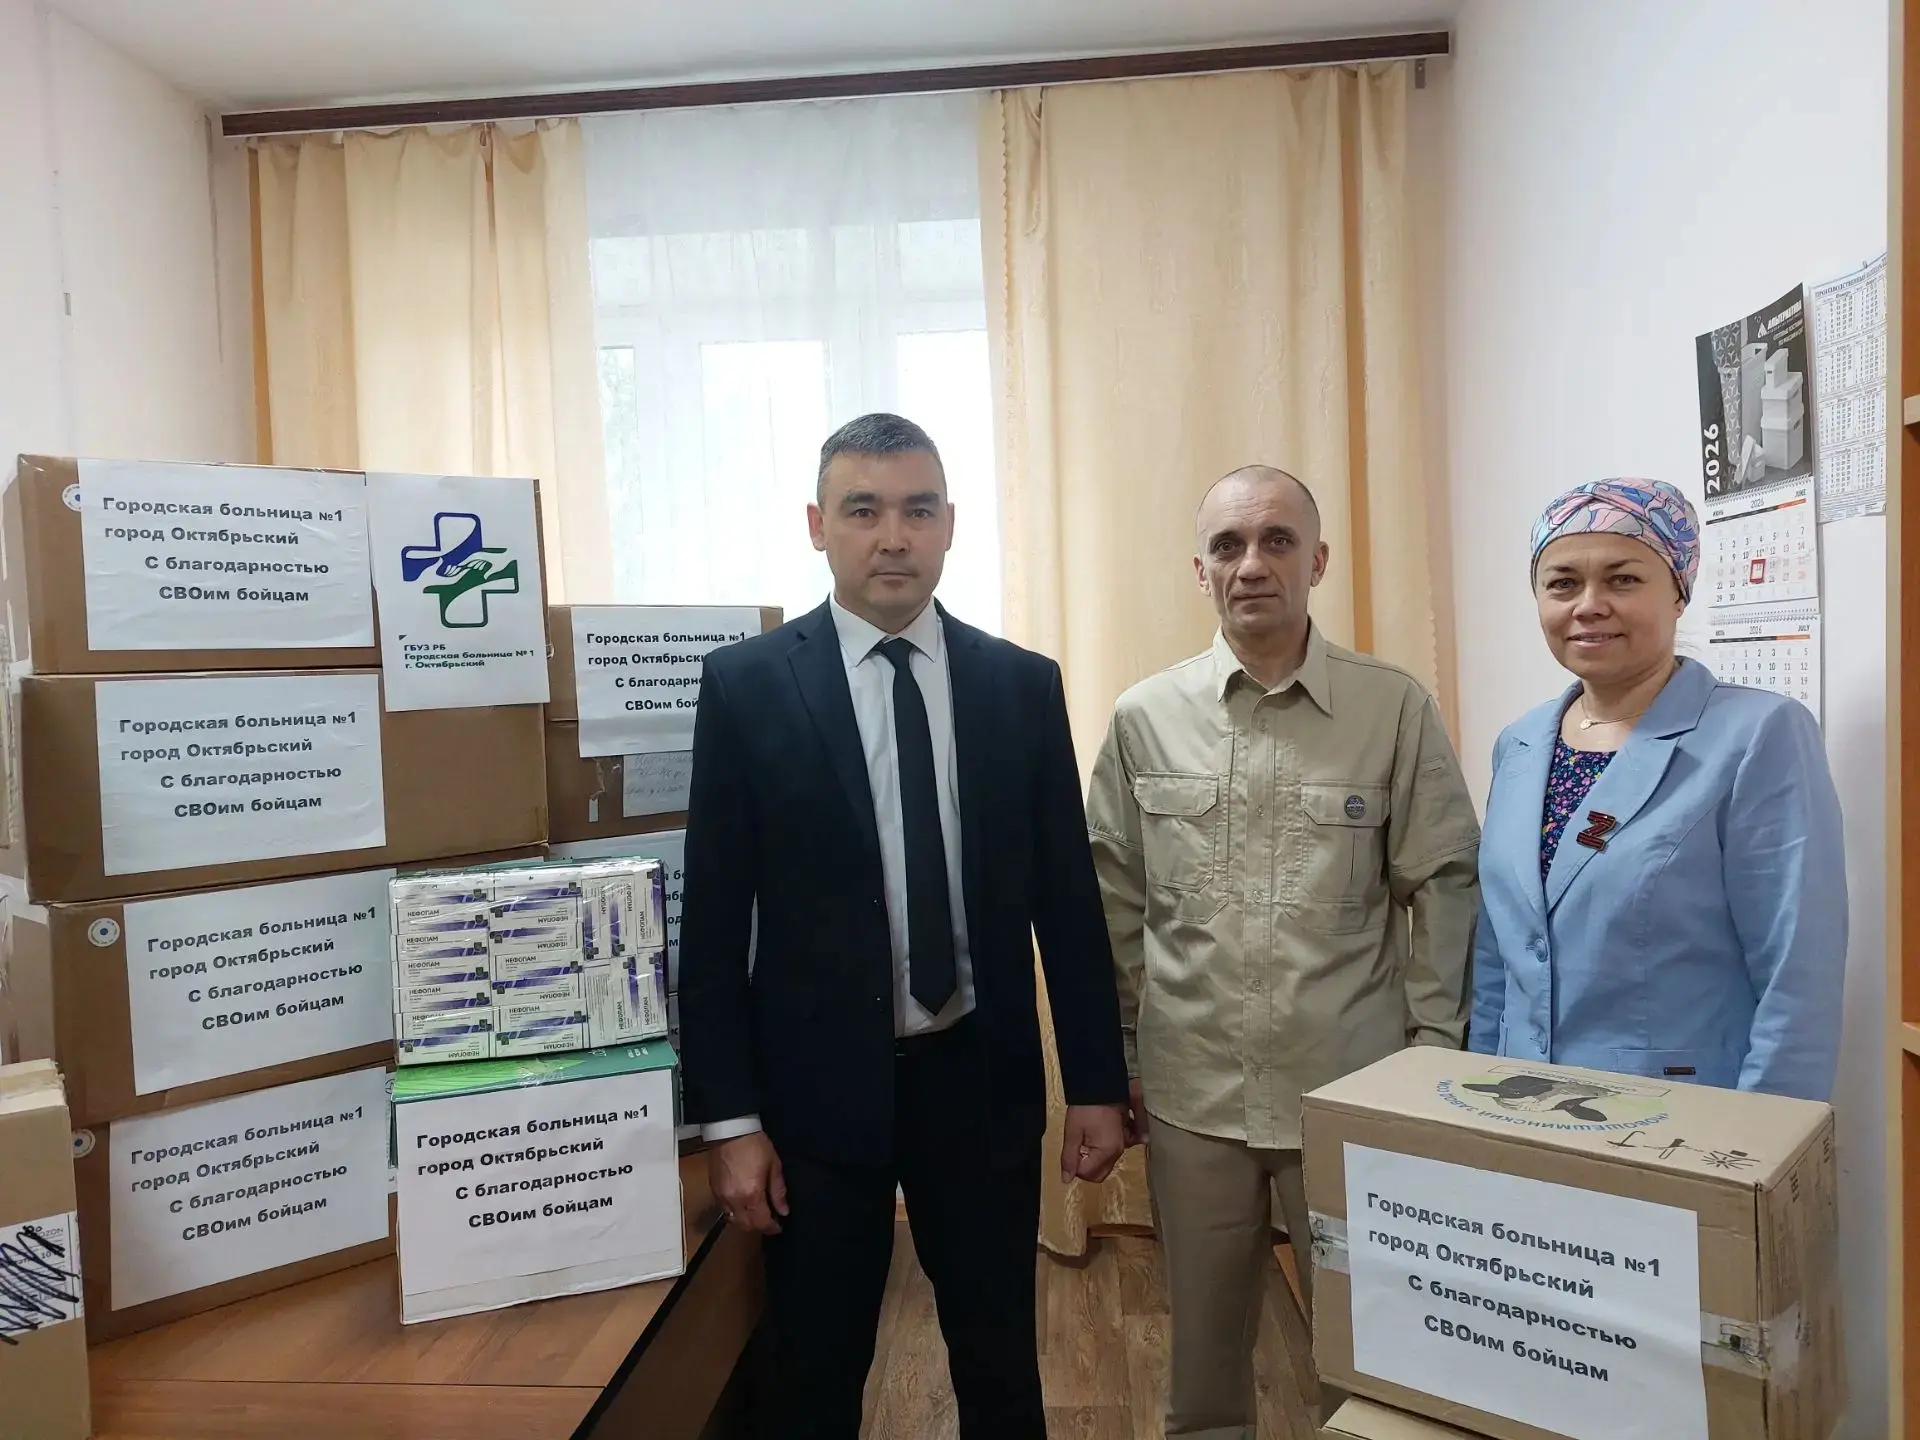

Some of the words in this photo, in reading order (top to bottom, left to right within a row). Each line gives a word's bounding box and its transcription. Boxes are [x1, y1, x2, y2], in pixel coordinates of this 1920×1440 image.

[1704, 423, 1721, 494] 2026
[102, 497, 213, 515] Городская
[219, 503, 313, 522] больница
[318, 509, 344, 522] №1
[104, 526, 165, 541] город
[171, 527, 300, 545] Октябрьский
[144, 556, 159, 570] С
[165, 556, 330, 575] благодарностью
[159, 585, 231, 601] СВОим
[236, 586, 310, 603] бойцам
[432, 643, 447, 651] РБ
[587, 633, 659, 646] Городская
[663, 631, 725, 644] больница
[729, 631, 746, 642] №1
[404, 652, 460, 661] Городская
[462, 650, 513, 659] больница
[415, 659, 485, 670] Октябрьский
[588, 655, 628, 667] город
[631, 653, 703, 666] Октябрьск
[1769, 662, 1775, 670] 10
[1784, 662, 1791, 670] 11
[1801, 662, 1808, 670] 12
[615, 677, 625, 688] С
[628, 676, 702, 688] благодарн
[1755, 676, 1761, 685] 16
[1769, 676, 1775, 685] 17
[1801, 677, 1808, 685] 19
[625, 699, 672, 712] СВОим
[676, 697, 699, 709] бой
[1801, 691, 1808, 700] 26
[119, 718, 229, 735] Городская
[234, 712, 327, 730] больница
[331, 711, 357, 725] №1
[120, 745, 181, 763] город
[186, 737, 313, 757] Октябрьский
[160, 775, 174, 789] С
[180, 765, 342, 788] благодарностью
[174, 801, 245, 818] СВОим
[250, 796, 322, 813] бойцам
[147, 927, 253, 953] Городская
[258, 912, 348, 936] больница
[352, 906, 377, 922] №1
[406, 935, 439, 944] НЕФОПАМ
[149, 958, 207, 980] город
[212, 938, 335, 970] Октябрьский
[505, 955, 537, 964] НЕФОПАМ
[188, 989, 201, 1003] С
[207, 962, 363, 1000] благодарностью
[201, 1008, 270, 1030] СВОим
[275, 994, 344, 1018] бойцам
[131, 1133, 238, 1165] Городская
[244, 1114, 334, 1142] больница
[339, 1106, 364, 1123] №1
[417, 1124, 521, 1149] Городская
[526, 1110, 618, 1134] больница
[624, 1104, 649, 1120] №1
[131, 1169, 190, 1193] город
[196, 1141, 320, 1178] Октябрьский
[417, 1157, 474, 1176] город
[480, 1137, 604, 1167] Октябрьский
[169, 1199, 183, 1214] С
[189, 1164, 348, 1210] благодарностью
[455, 1186, 469, 1200] С
[474, 1163, 633, 1198] благодарностью
[182, 1215, 251, 1241] СВОим
[257, 1196, 327, 1223] бойцам
[468, 1207, 536, 1228] СВОим
[542, 1196, 613, 1217] бойцам
[1367, 1192, 1484, 1235] Городская
[1491, 1222, 1615, 1266] больница
[1624, 1256, 1661, 1277] №1
[1368, 1228, 1429, 1259] город
[1436, 1243, 1595, 1299] Октябрьский
[1407, 1274, 1423, 1291] С
[1429, 1279, 1637, 1350] благодарностью
[1424, 1313, 1505, 1352] СВОим
[1512, 1339, 1609, 1382] бойцам
